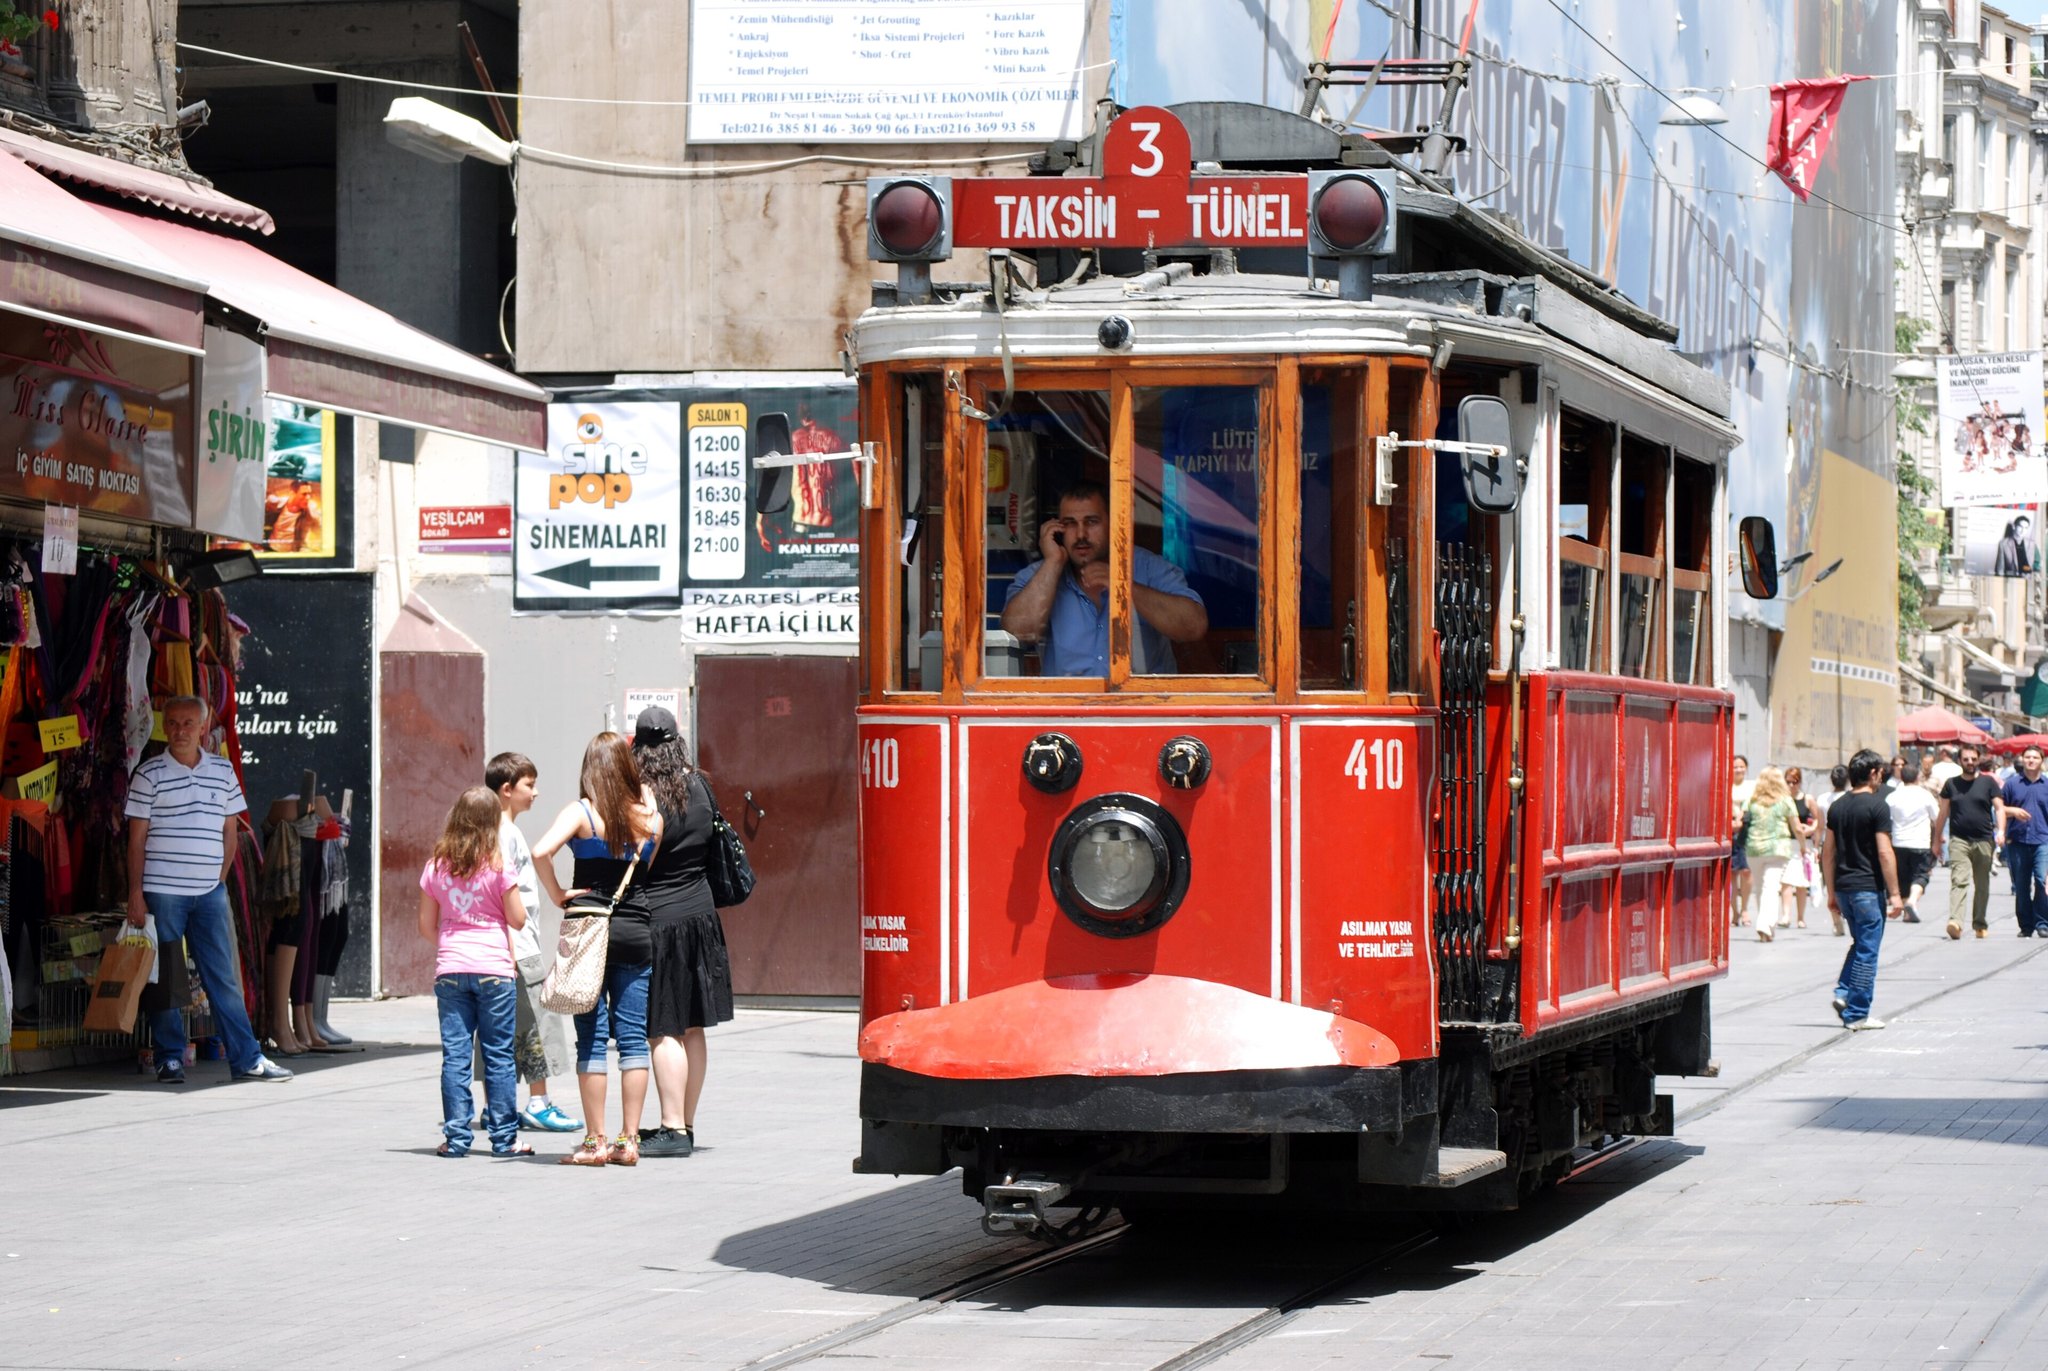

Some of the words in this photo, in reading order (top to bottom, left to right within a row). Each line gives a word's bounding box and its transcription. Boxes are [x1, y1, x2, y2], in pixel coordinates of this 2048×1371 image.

[737, 15, 768, 24] Zemin
[771, 14, 834, 25] Mühendisliği
[860, 16, 875, 25] Jet
[878, 15, 921, 27] Grouting
[994, 12, 1036, 21] Kazıklar
[737, 32, 769, 43] Ankraj
[884, 32, 920, 42] Sistemi
[923, 31, 965, 43] Projeleri
[994, 30, 1015, 39] Fore
[1018, 29, 1046, 38] Kazık
[736, 49, 789, 60] Enjeksiyon
[860, 50, 882, 59] Shot
[891, 49, 912, 59] Cret
[993, 46, 1019, 56] Vibro
[1023, 46, 1051, 56] Kazık
[736, 66, 764, 75] Temel
[767, 65, 809, 77] Projeleri
[993, 64, 1016, 73] Mini
[1019, 63, 1047, 73] Kazık
[698, 92, 738, 103] TEMEL
[924, 92, 937, 103] VE
[941, 90, 1008, 103] EKONOMİK
[1012, 88, 1079, 104] ÇÖZÜMLER
[720, 123, 773, 134] Tel:0216
[777, 123, 799, 134] 385
[803, 123, 817, 134] 81
[822, 123, 838, 134] 46
[849, 123, 872, 134] 369
[876, 123, 891, 134] 90
[895, 123, 910, 134] 66
[914, 122, 971, 134] Fax:0216
[974, 122, 998, 133] 369
[1002, 122, 1017, 132] 93
[1021, 121, 1036, 132] 58
[1129, 121, 1165, 178] 3
[994, 186, 1116, 239] TAKSİM
[1186, 186, 1304, 239] TÜNEL
[1949, 368, 1959, 377] VE
[1992, 364, 2022, 375] GÜCÜNE
[9, 374, 64, 426] Miss
[697, 409, 732, 423] SALON
[735, 409, 740, 422] 1
[207, 400, 267, 464] ŞİRİN
[1212, 428, 1256, 450] LÜTF
[562, 421, 648, 476] sine
[694, 435, 741, 452] 12:00
[17, 447, 28, 478] İÇ
[33, 452, 62, 480] GİYİM
[66, 462, 94, 491] SATIŞ
[99, 468, 140, 495] NOKTASI
[694, 461, 741, 478] 14:15
[549, 473, 633, 510] pop
[695, 486, 741, 503] 16:30
[421, 510, 485, 528] YEŞİLÇAM
[694, 510, 741, 527] 18:45
[530, 518, 667, 550] SİNEMALARI
[50, 535, 64, 563] 10
[693, 537, 740, 553] 21:00
[778, 543, 812, 555] KAN
[814, 543, 859, 554] KİTAB
[693, 592, 801, 605] PAZARTESİ
[696, 615, 771, 634] HAFTA
[779, 610, 808, 637] İÇİ
[818, 610, 855, 633] İLK
[297, 714, 338, 740] için
[51, 733, 65, 746] 15
[862, 738, 899, 789] 410
[1344, 738, 1404, 790] 410
[877, 915, 907, 931] YASAK
[1340, 920, 1388, 936] ASILMAK
[1388, 920, 1413, 936] YASAK
[1338, 942, 1355, 958] VE
[1356, 939, 1414, 958] TEHLİKELİDİR
